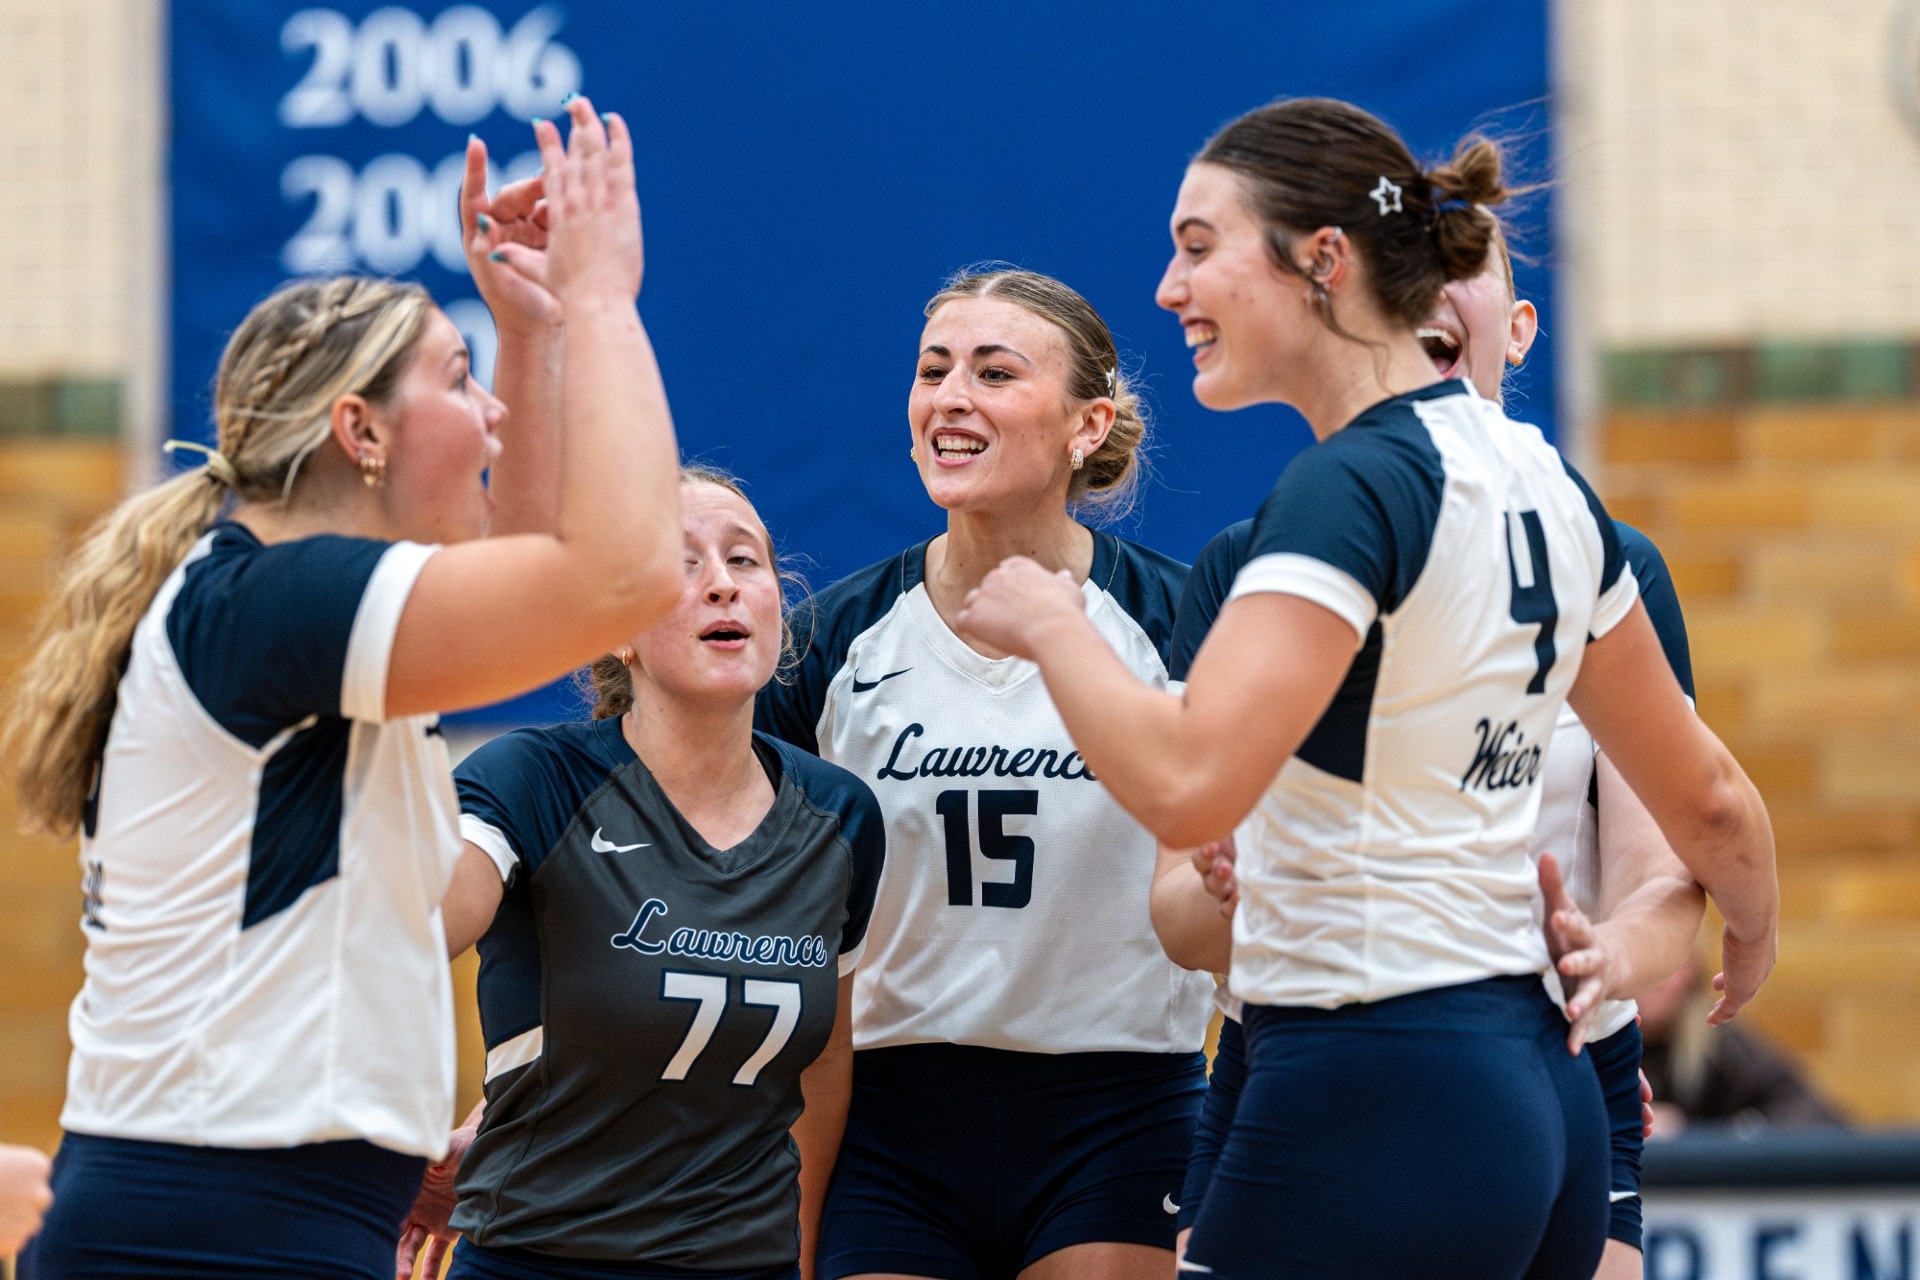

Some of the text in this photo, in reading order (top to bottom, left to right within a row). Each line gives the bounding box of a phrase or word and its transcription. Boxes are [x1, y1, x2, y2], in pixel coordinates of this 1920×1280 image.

[279, 4, 583, 128] 2006
[279, 151, 545, 276] 200
[1504, 509, 1558, 695] 4
[1459, 716, 1542, 793] Weier
[936, 789, 1039, 909] 15
[611, 898, 827, 967] Lawrence
[658, 968, 804, 1088] 77
